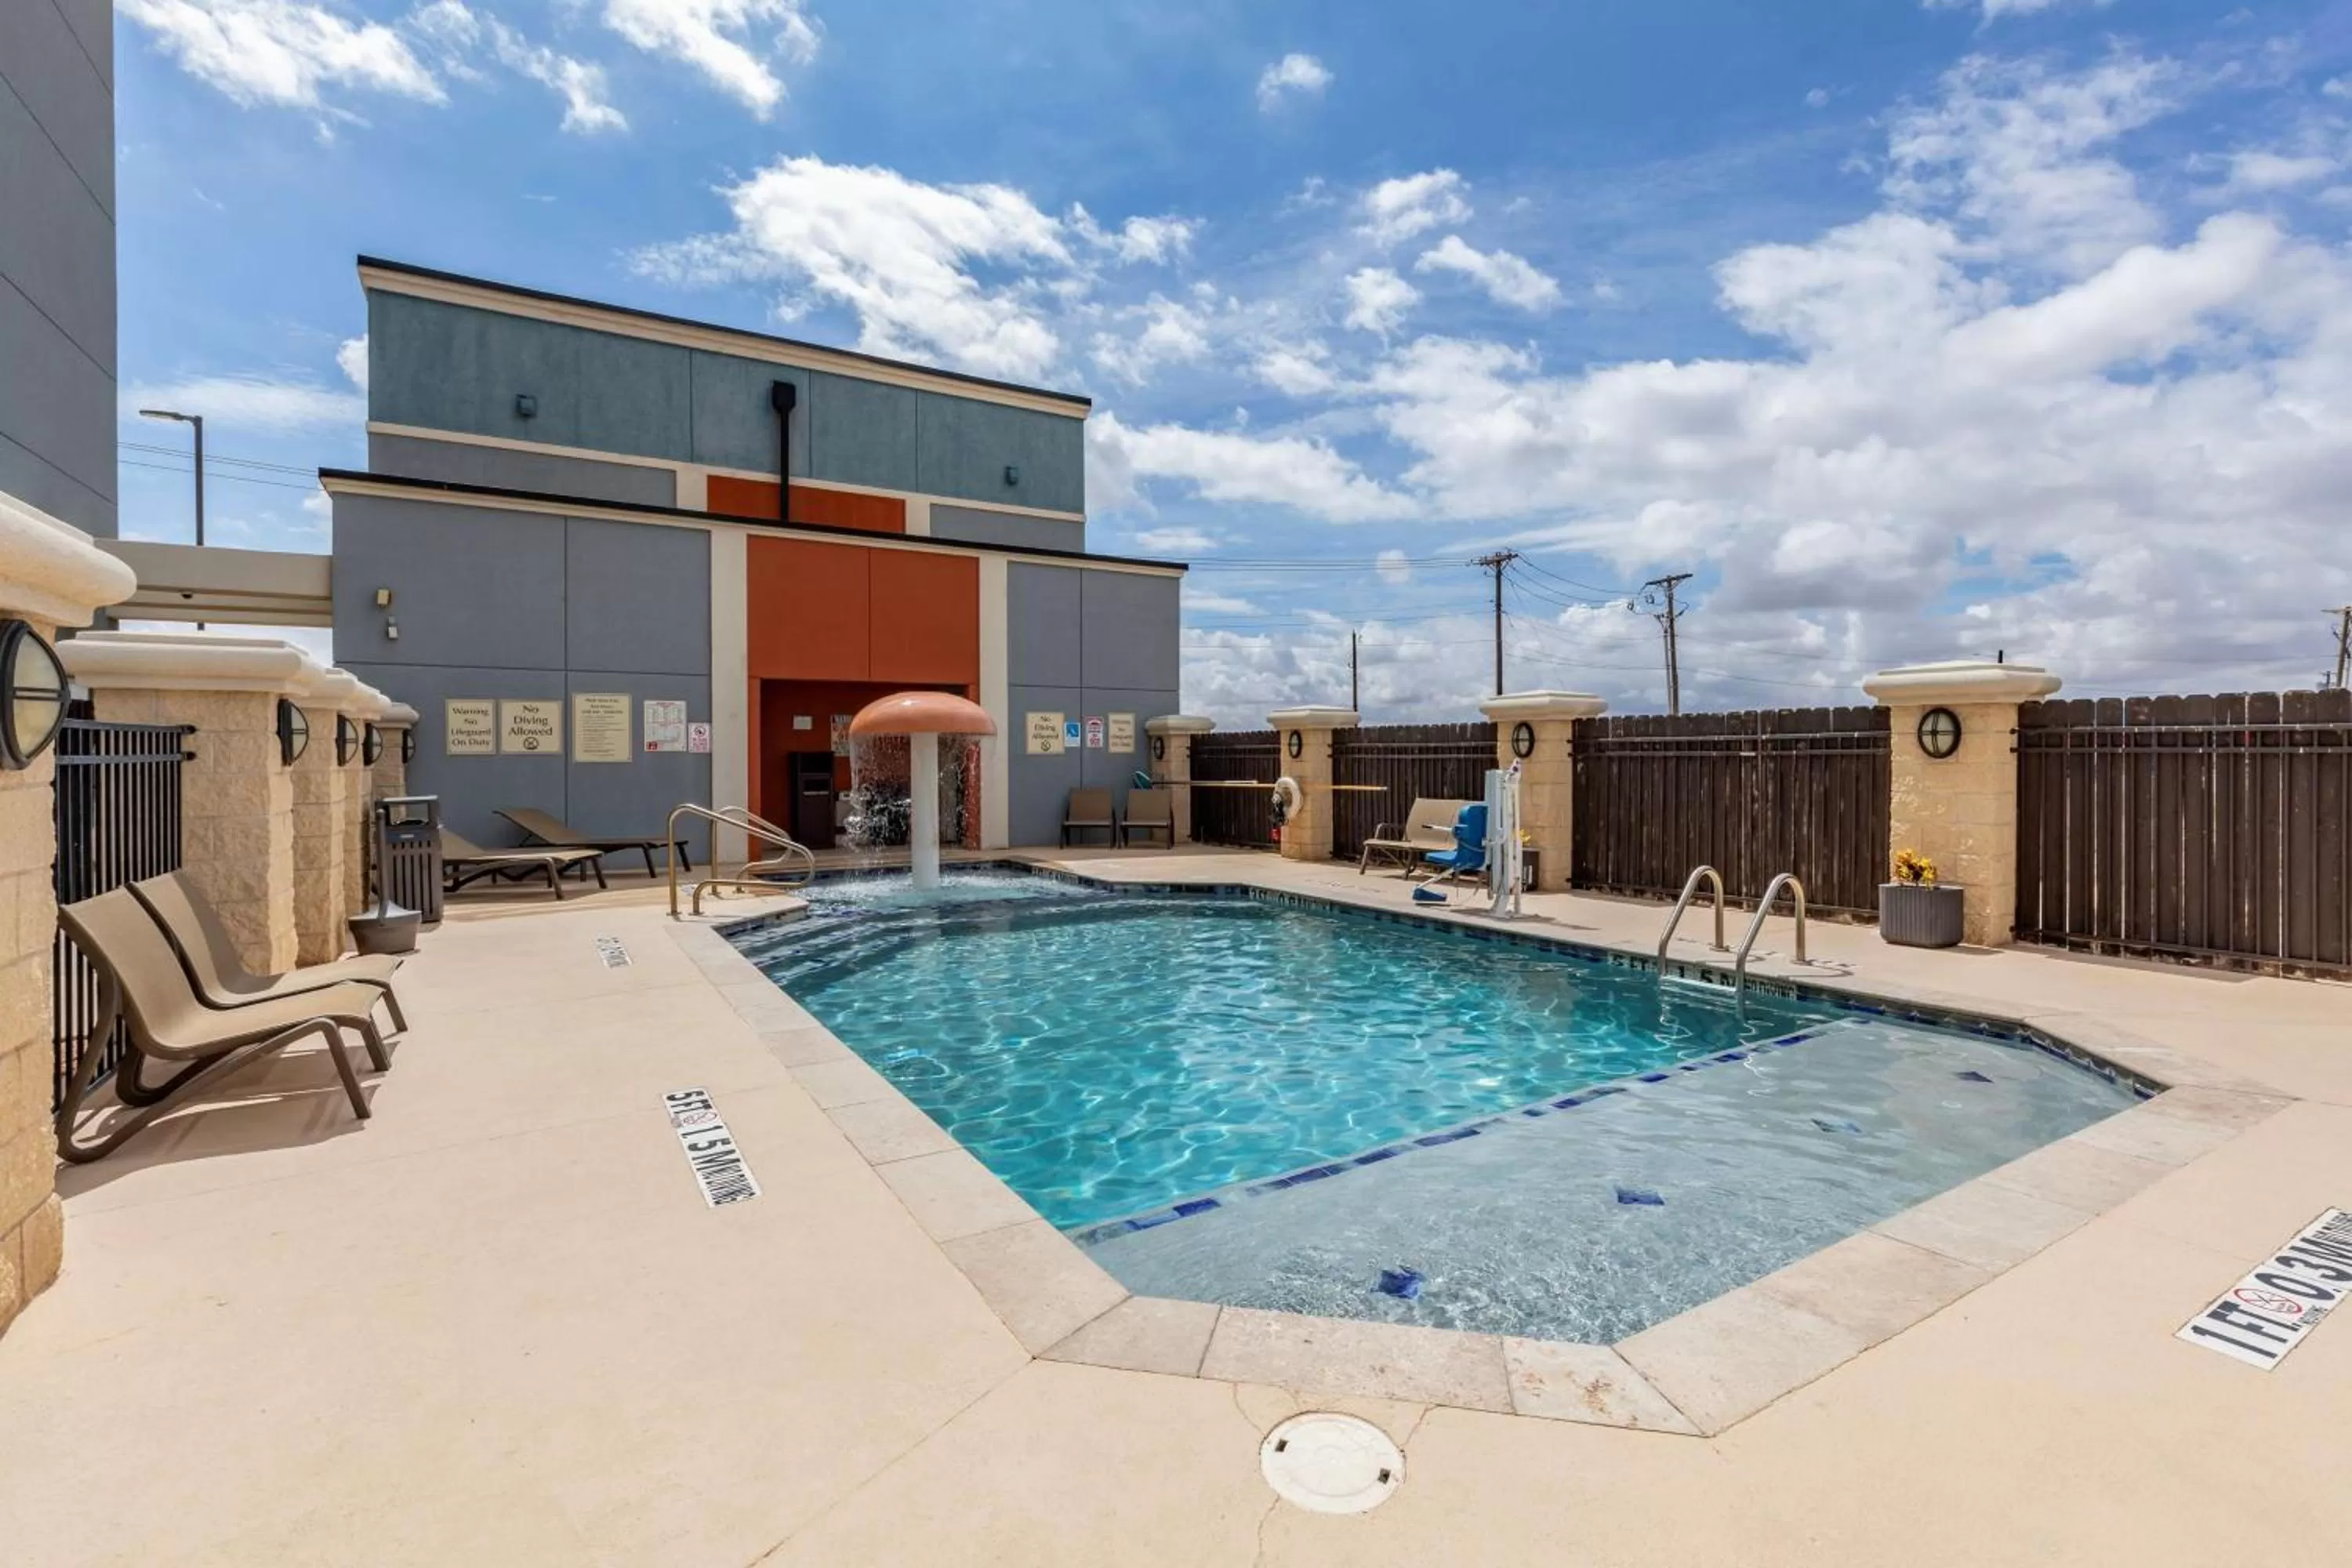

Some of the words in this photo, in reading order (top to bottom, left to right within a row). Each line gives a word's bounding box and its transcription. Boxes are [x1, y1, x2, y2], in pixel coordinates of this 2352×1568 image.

[452, 707, 488, 717] Warning
[523, 704, 539, 713] No
[514, 714, 548, 727] Diving
[508, 727, 553, 735] Allowed
